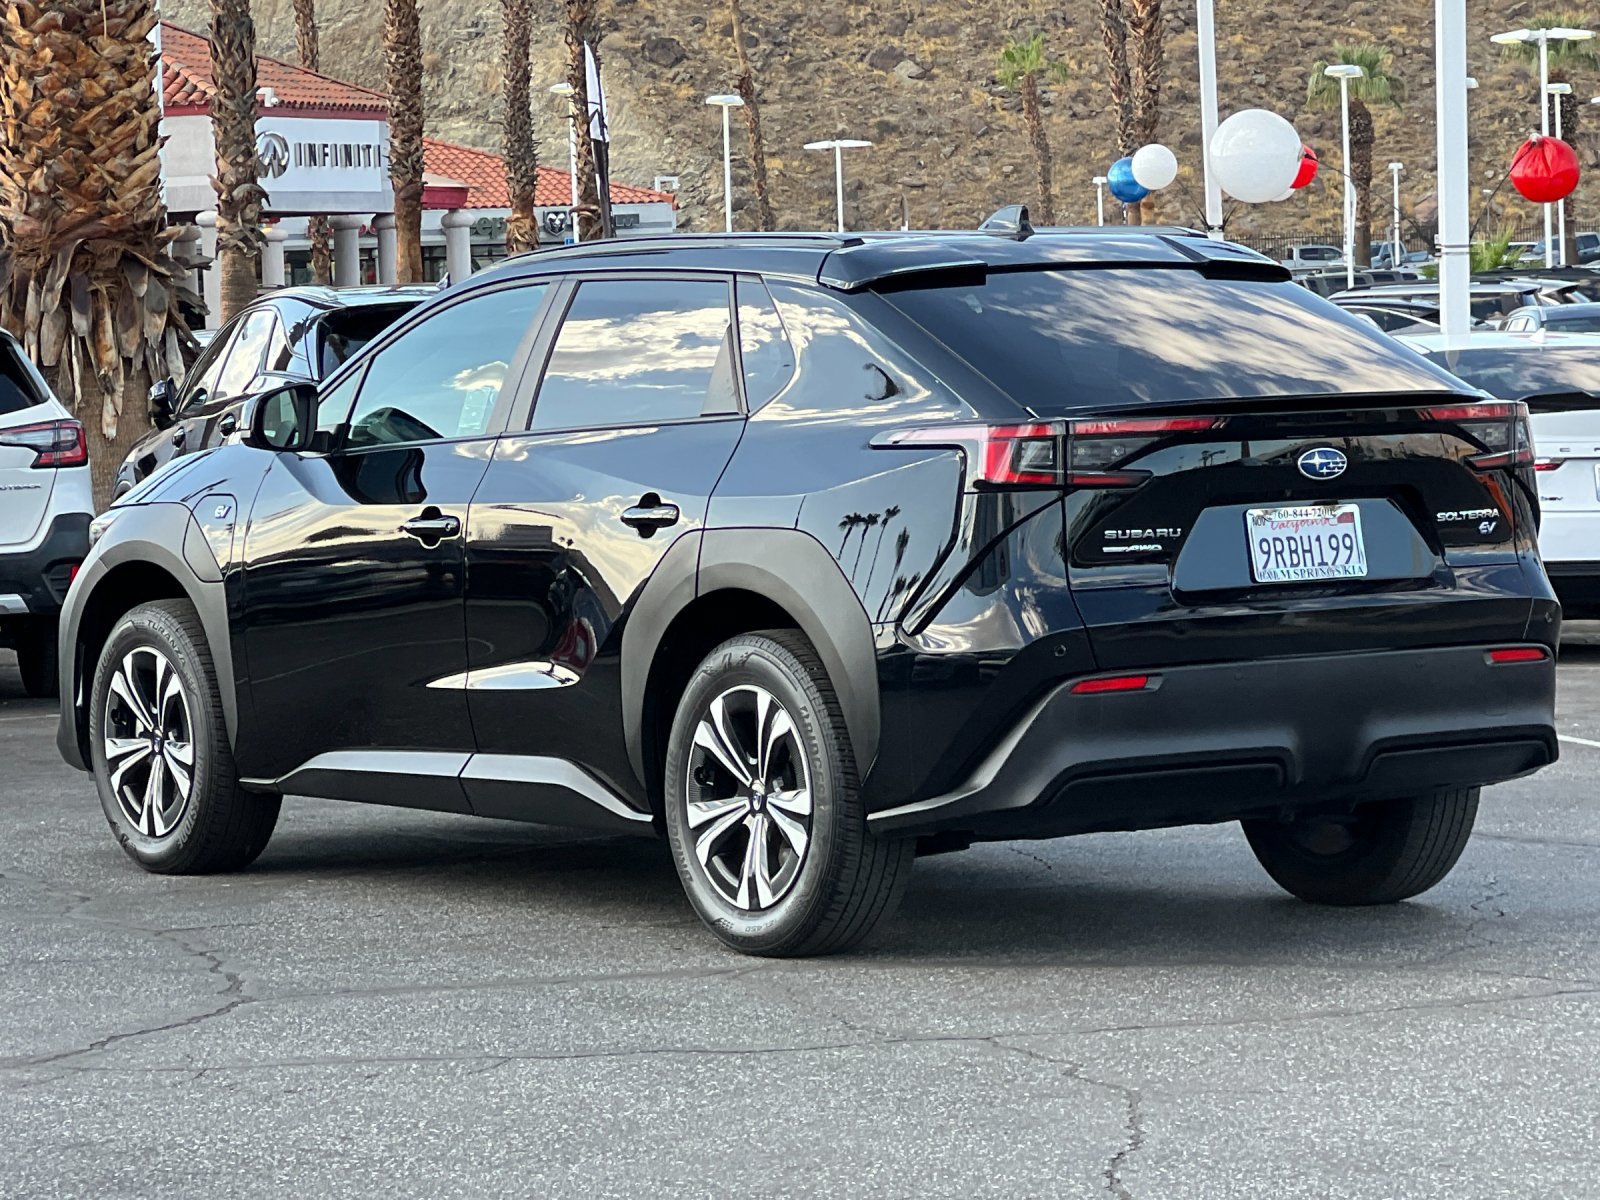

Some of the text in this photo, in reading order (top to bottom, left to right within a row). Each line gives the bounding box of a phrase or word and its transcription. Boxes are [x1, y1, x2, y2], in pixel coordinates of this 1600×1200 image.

[294, 142, 381, 168] INFINITI
[470, 216, 508, 240] ep
[1436, 508, 1500, 522] SOLTERRA
[1104, 528, 1182, 539] SUBARU
[1478, 521, 1497, 535] EV
[1259, 533, 1354, 570] 9RBH199
[1293, 565, 1342, 579] SPRINGS
[1343, 564, 1365, 575] KIA
[800, 705, 829, 830] BRIDGES
